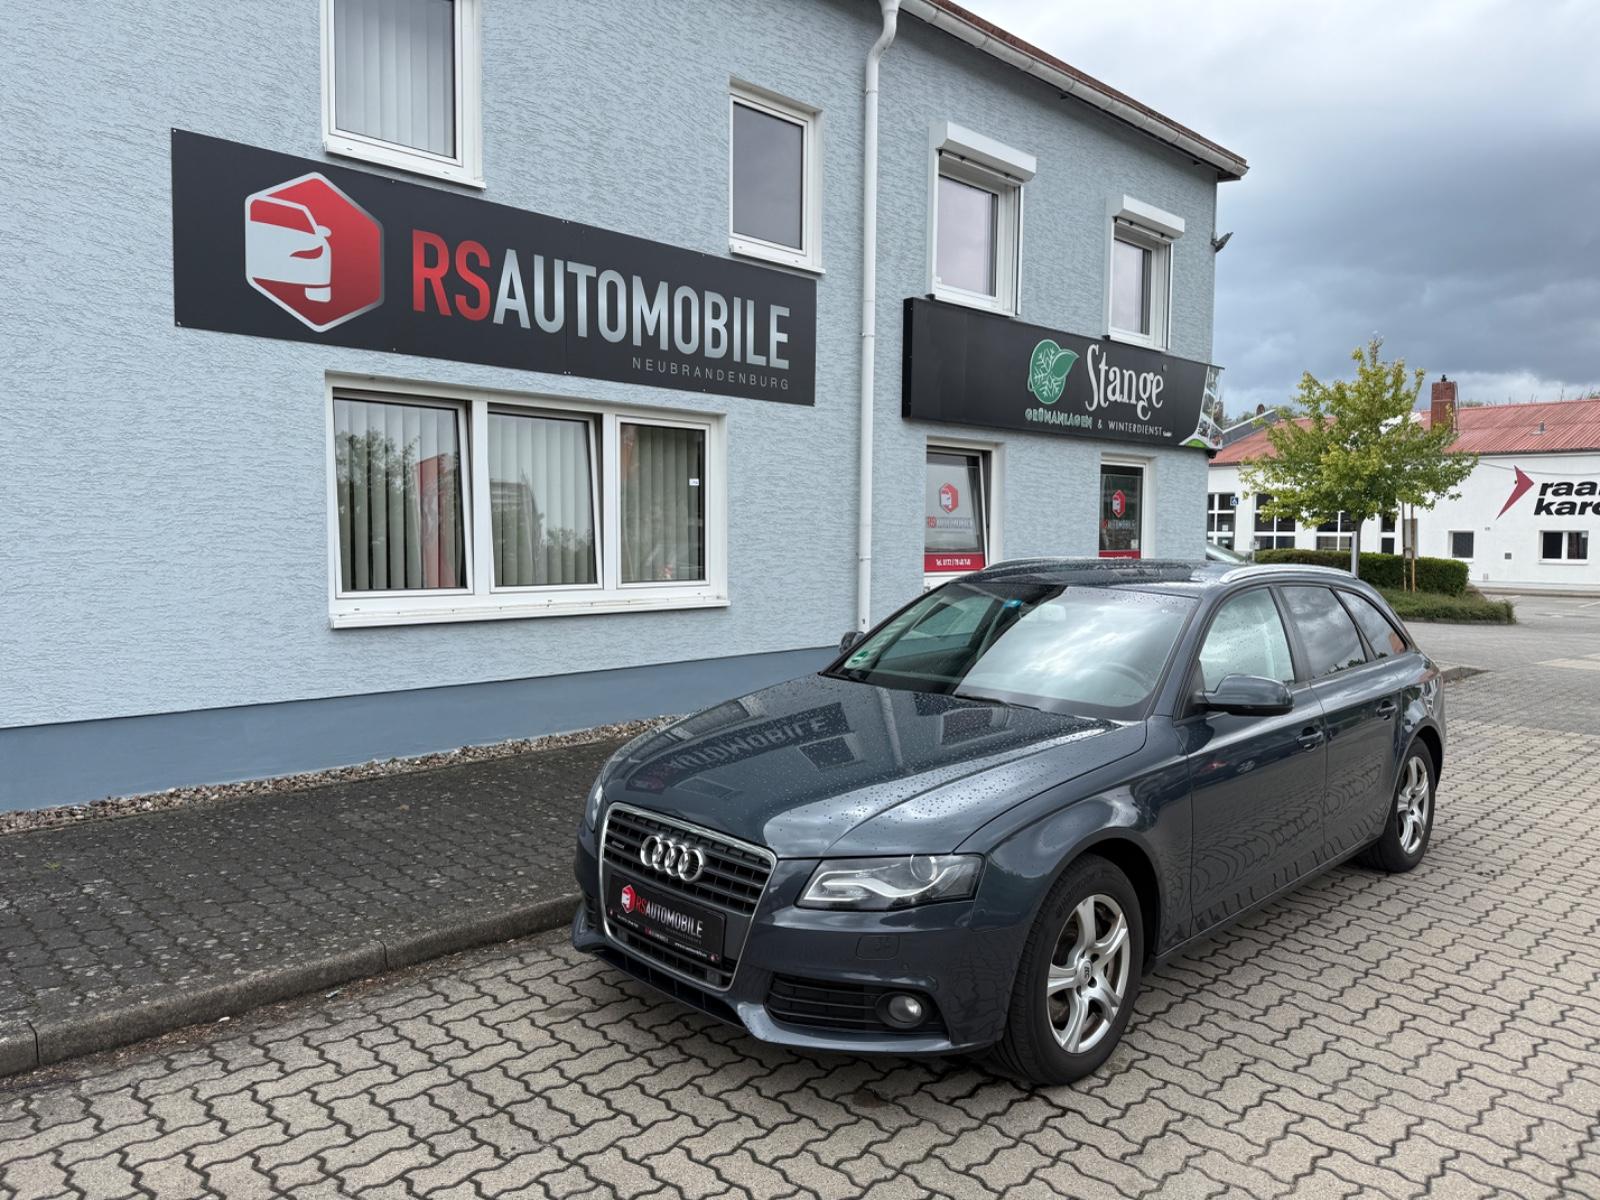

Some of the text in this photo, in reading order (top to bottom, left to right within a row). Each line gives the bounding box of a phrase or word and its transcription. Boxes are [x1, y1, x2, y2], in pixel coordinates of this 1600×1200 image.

[411, 228, 791, 371] RSAUTOMOBILE
[632, 357, 789, 391] NEUBRANDENBURG
[1085, 344, 1164, 421] Stange
[1107, 420, 1162, 437] WINTERDIENST
[1538, 481, 1600, 497] raa
